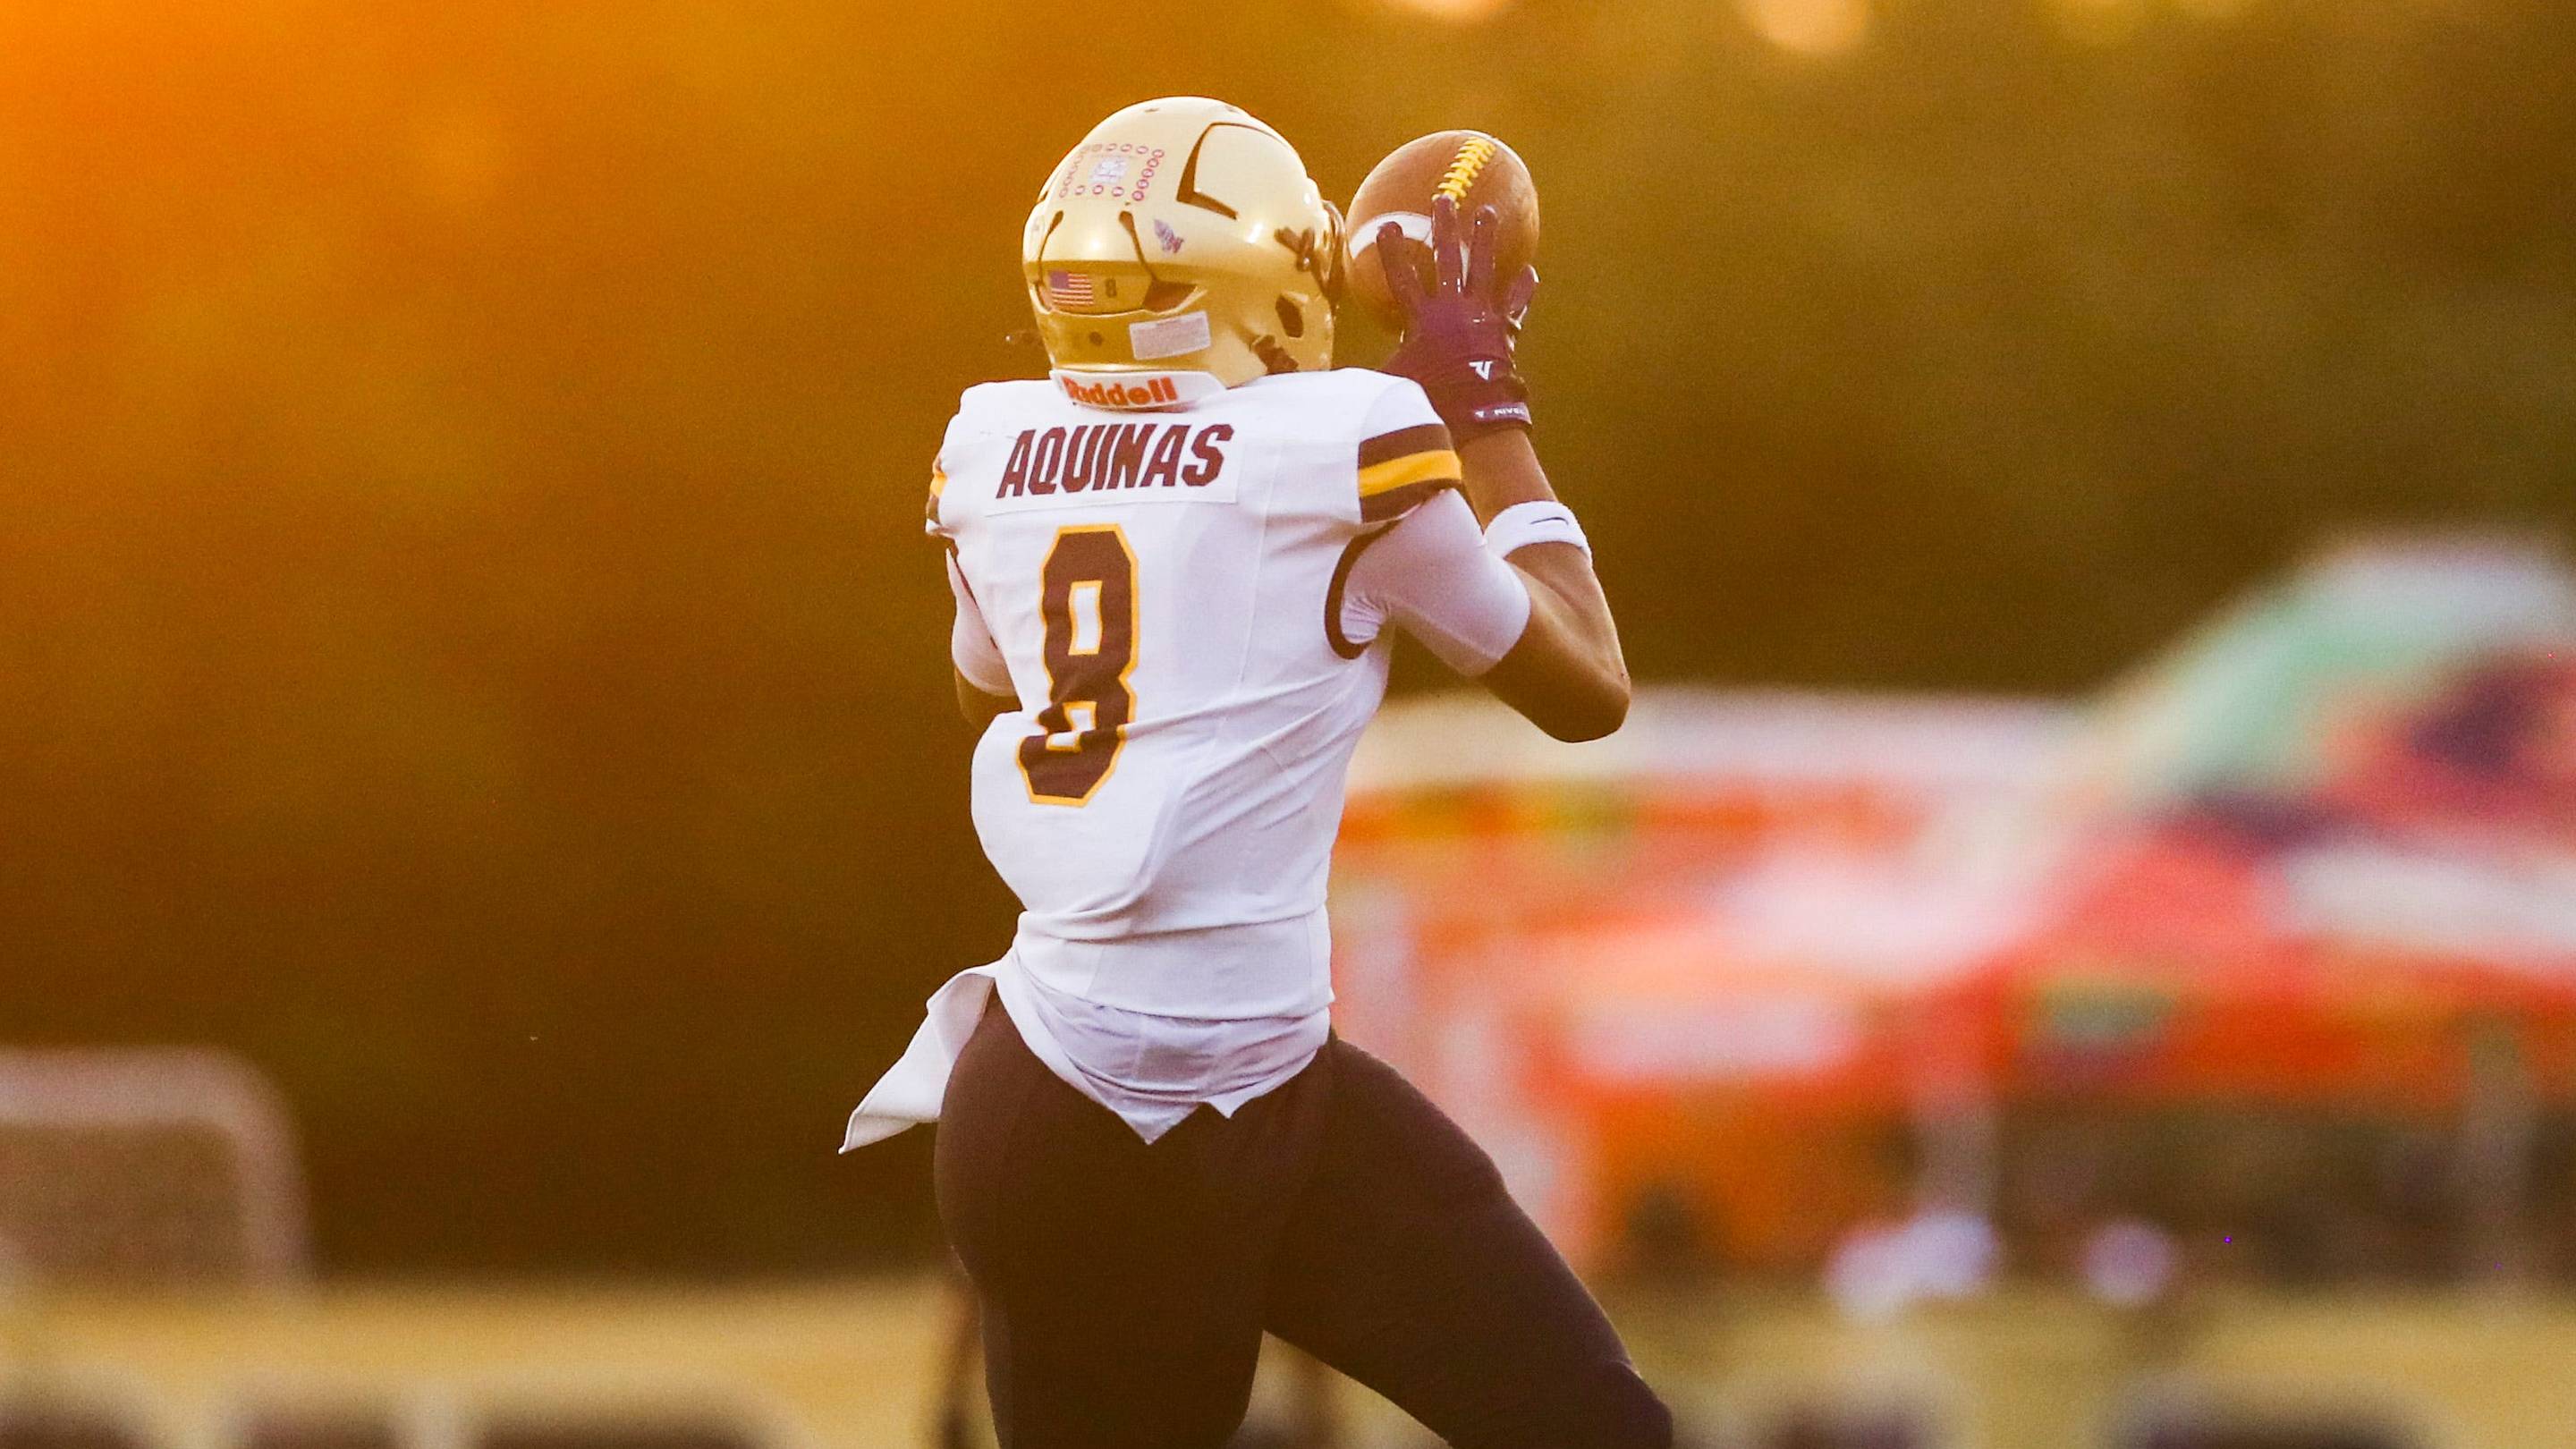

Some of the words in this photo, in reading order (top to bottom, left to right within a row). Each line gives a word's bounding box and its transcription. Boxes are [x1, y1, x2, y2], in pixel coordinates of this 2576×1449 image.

[1061, 375, 1179, 405] Riddell
[996, 423, 1235, 499] AQUINAS
[1015, 523, 1140, 808] 8
